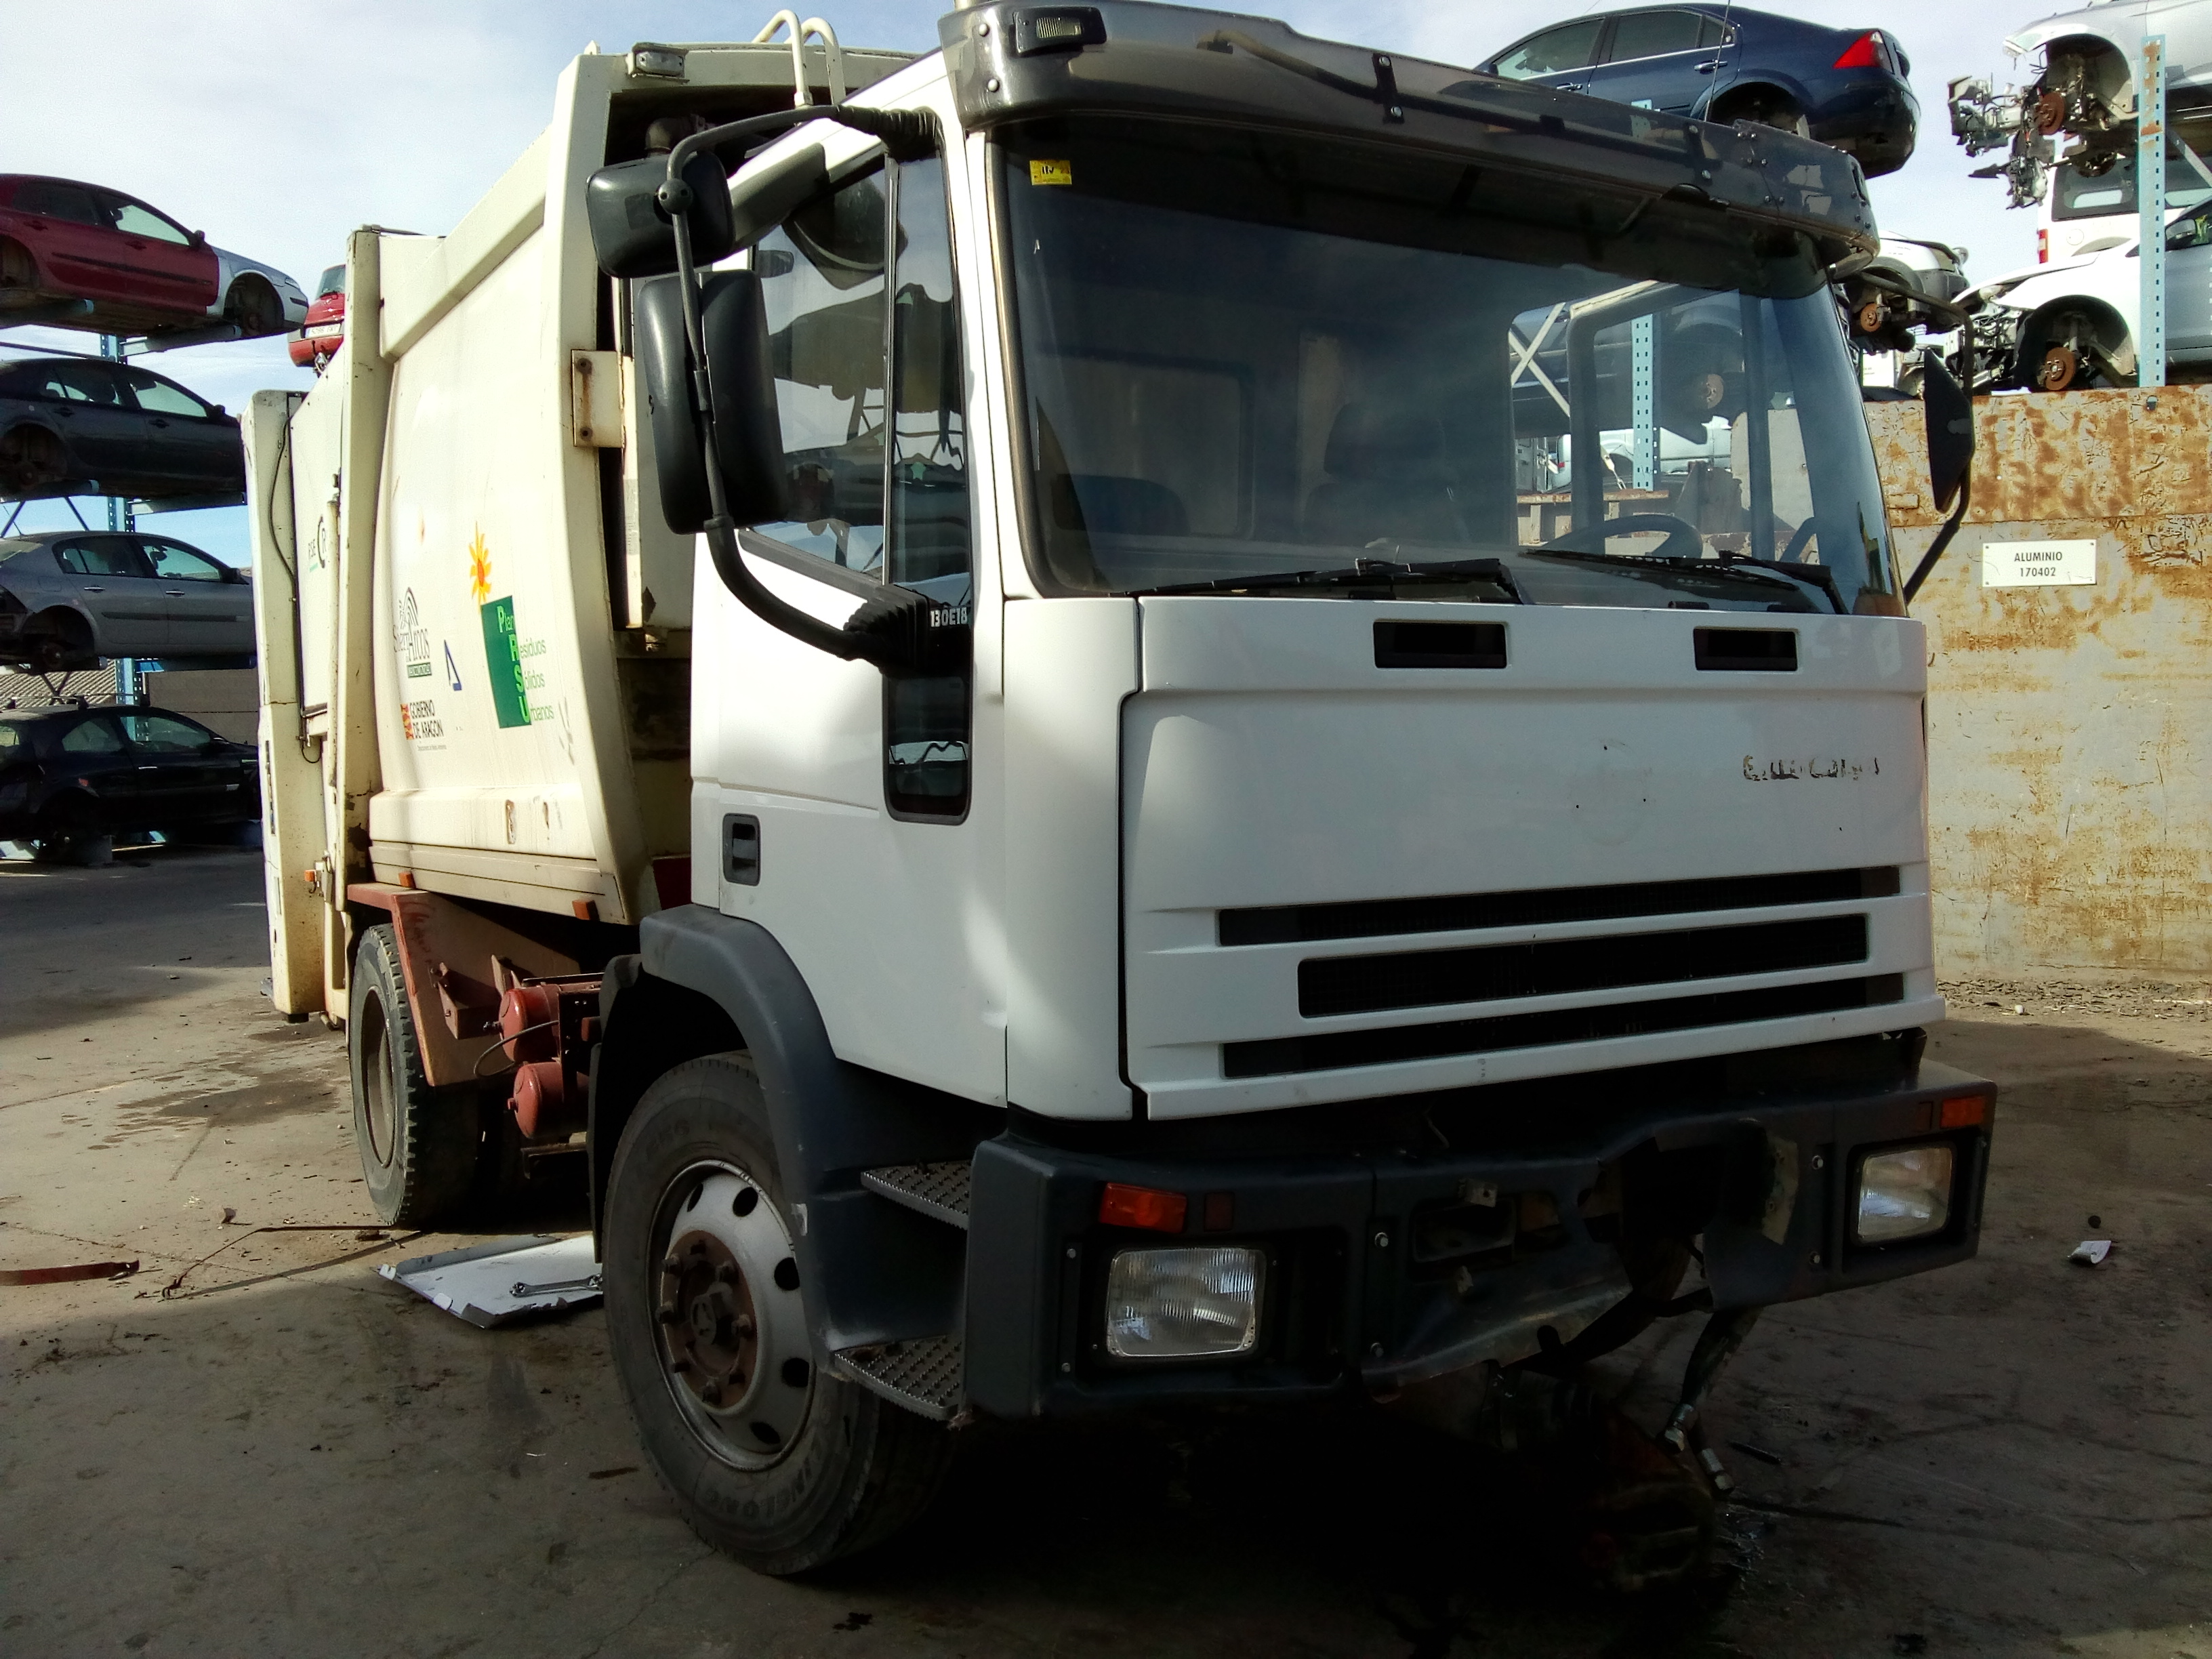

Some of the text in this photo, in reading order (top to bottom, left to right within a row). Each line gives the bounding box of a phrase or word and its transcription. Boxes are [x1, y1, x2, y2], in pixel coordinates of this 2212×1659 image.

[2013, 551, 2063, 562] ALUMINIO
[2020, 567, 2056, 577] 170402
[496, 605, 516, 633] Plan
[930, 607, 968, 628] 130E18
[508, 633, 547, 662] Residuos
[518, 695, 554, 724] Urbanos
[412, 721, 422, 739] DE
